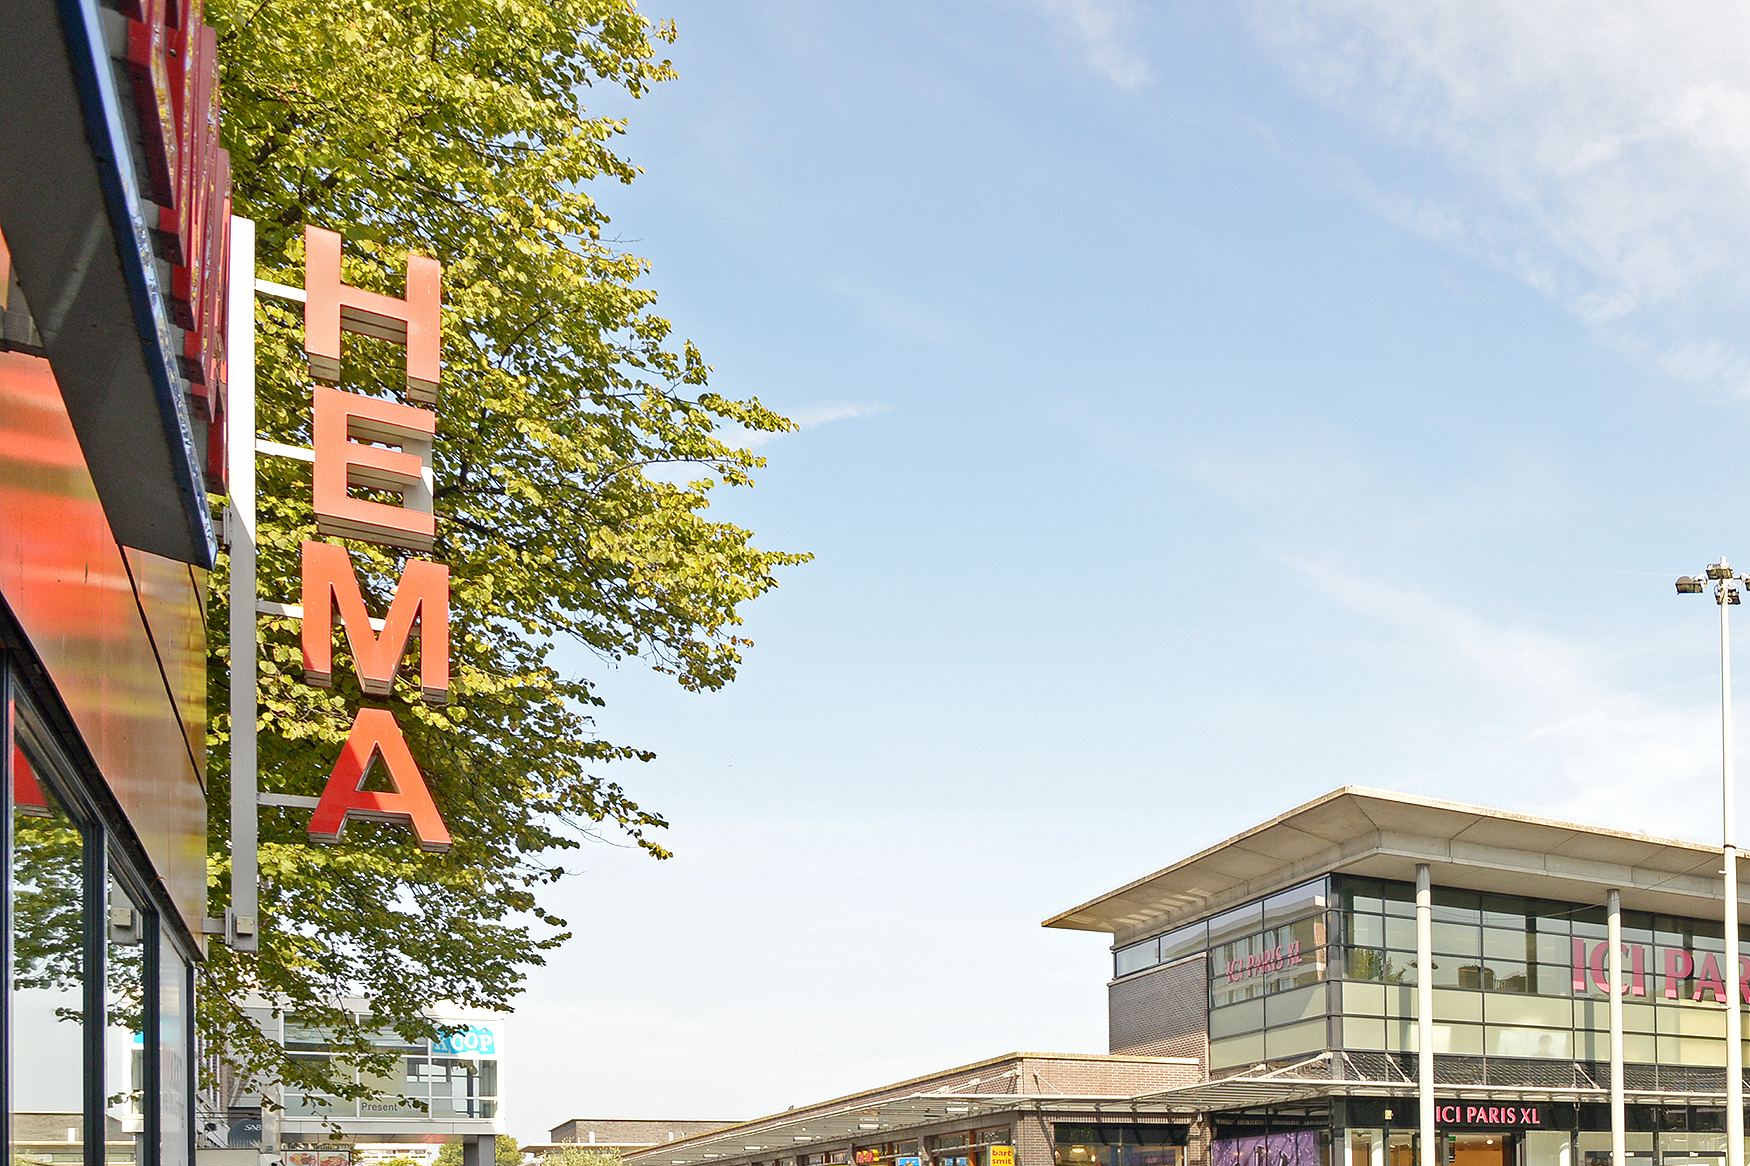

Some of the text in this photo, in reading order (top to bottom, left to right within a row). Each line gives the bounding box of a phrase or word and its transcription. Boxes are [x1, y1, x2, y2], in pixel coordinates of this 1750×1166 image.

[304, 225, 452, 853] HEMA
[1226, 940, 1303, 983] ICI PARIS XL
[1572, 938, 1646, 997] ICI
[361, 1102, 398, 1112] Present
[1435, 1105, 1541, 1124] ICI PARIS XL
[992, 1149, 1012, 1157] bart
